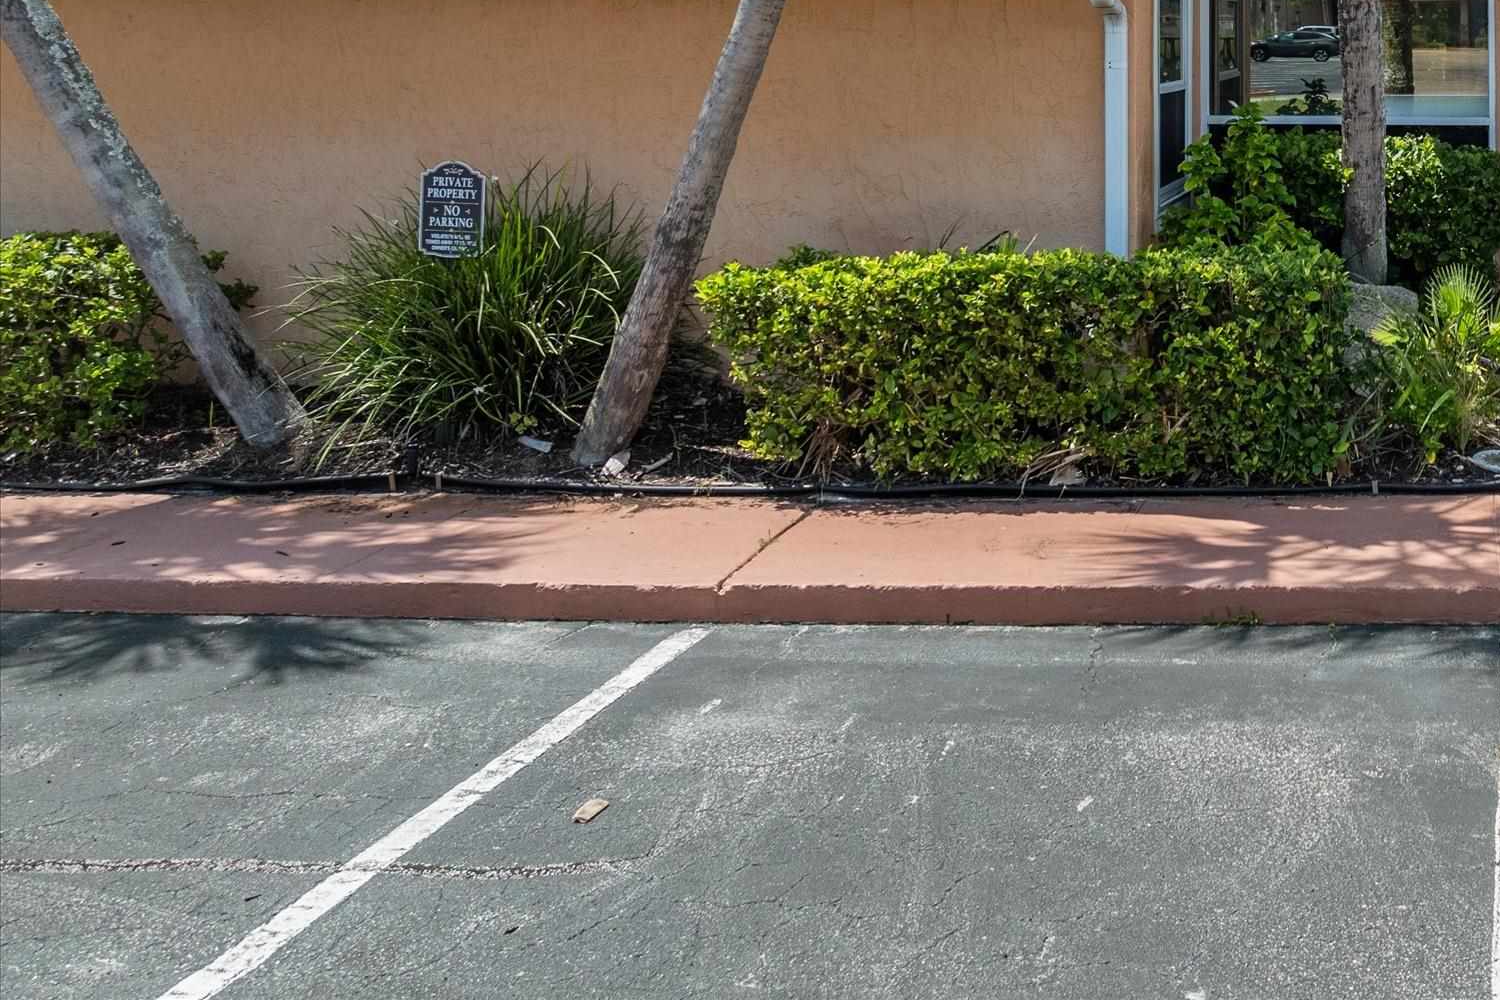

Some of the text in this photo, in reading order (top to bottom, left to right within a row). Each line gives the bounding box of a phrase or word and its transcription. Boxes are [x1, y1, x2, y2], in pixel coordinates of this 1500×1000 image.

[433, 176, 473, 187] PRIVATE
[427, 187, 477, 199] PROPERTY
[443, 205, 460, 216] NO
[429, 216, 473, 228] PARKING
